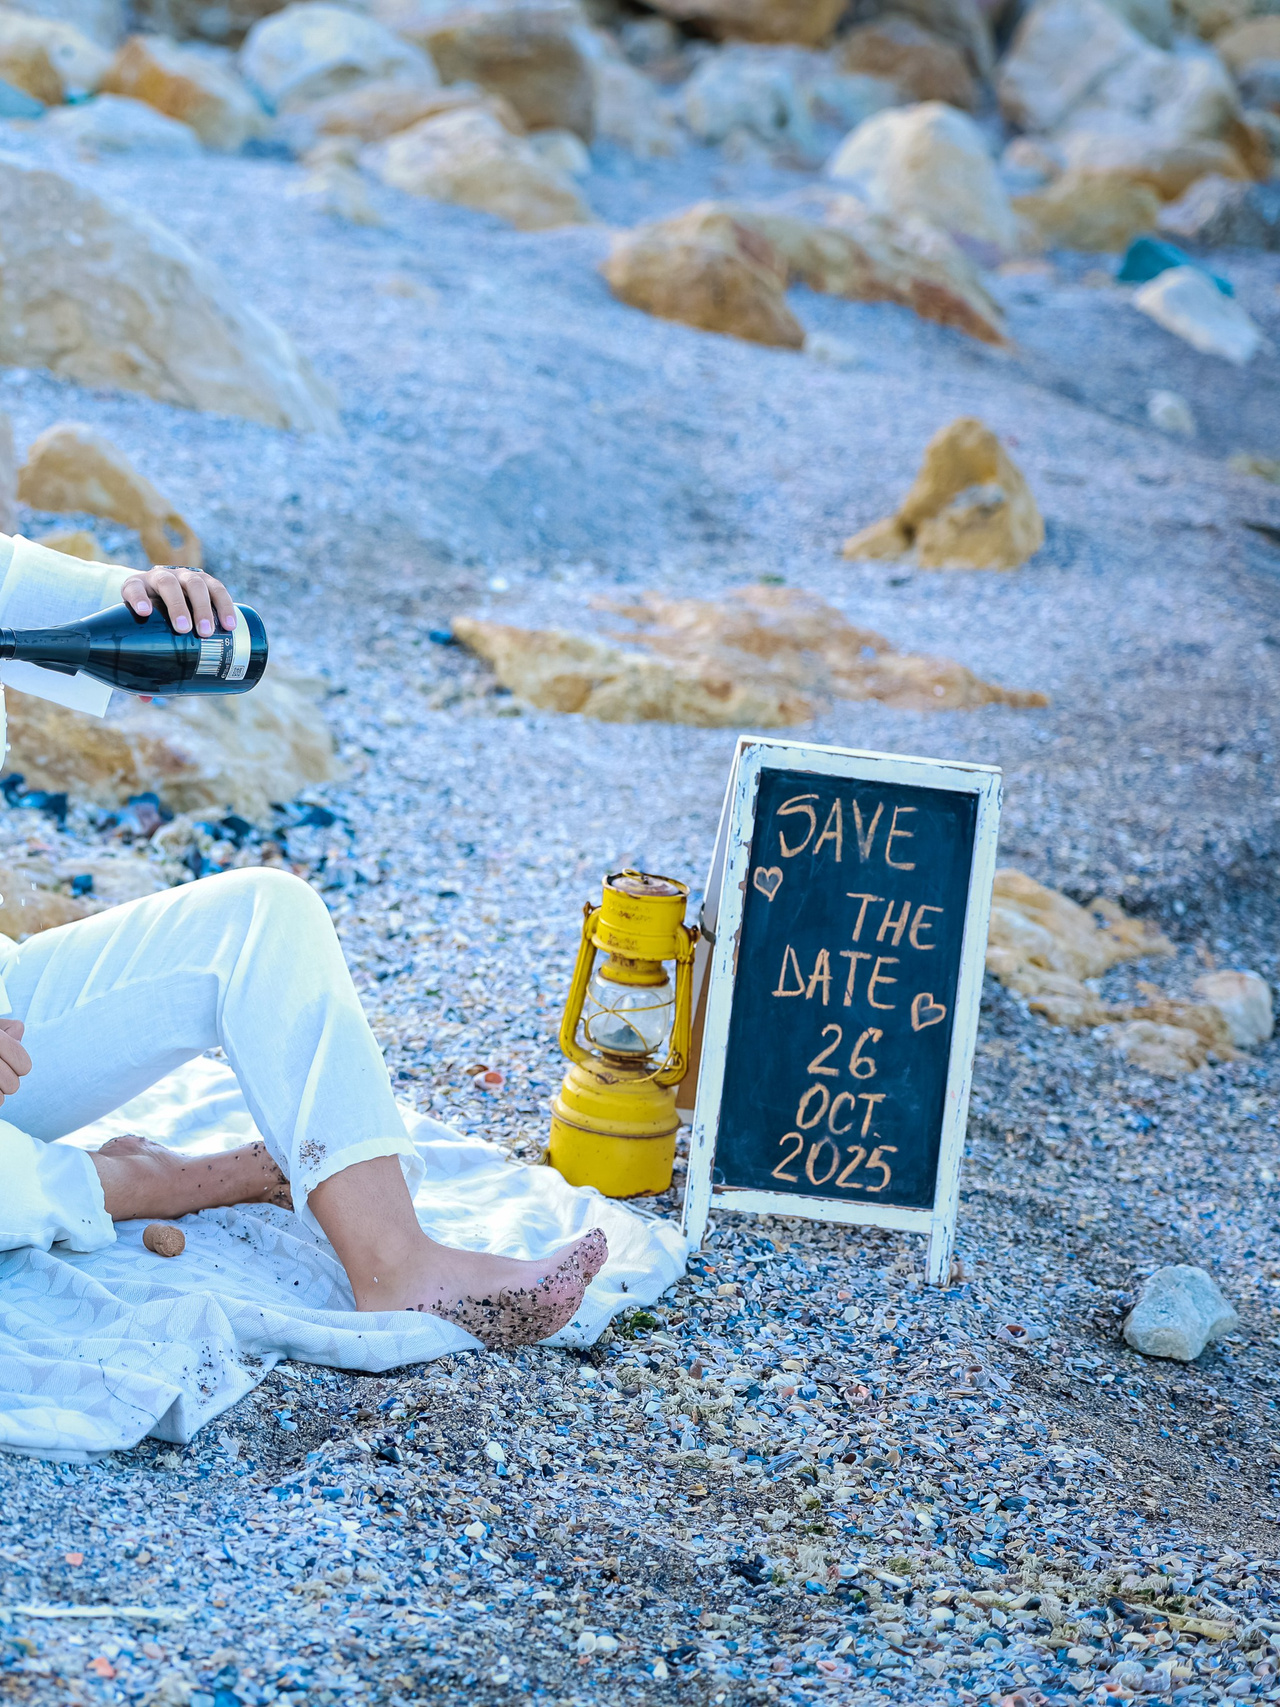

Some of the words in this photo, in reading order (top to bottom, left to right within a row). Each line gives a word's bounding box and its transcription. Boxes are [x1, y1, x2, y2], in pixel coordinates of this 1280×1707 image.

[776, 794, 918, 870] SAVE
[846, 892, 944, 950] THE
[771, 944, 900, 1009] DATE
[807, 1023, 883, 1079] 26
[771, 1132, 898, 1192] 2025
